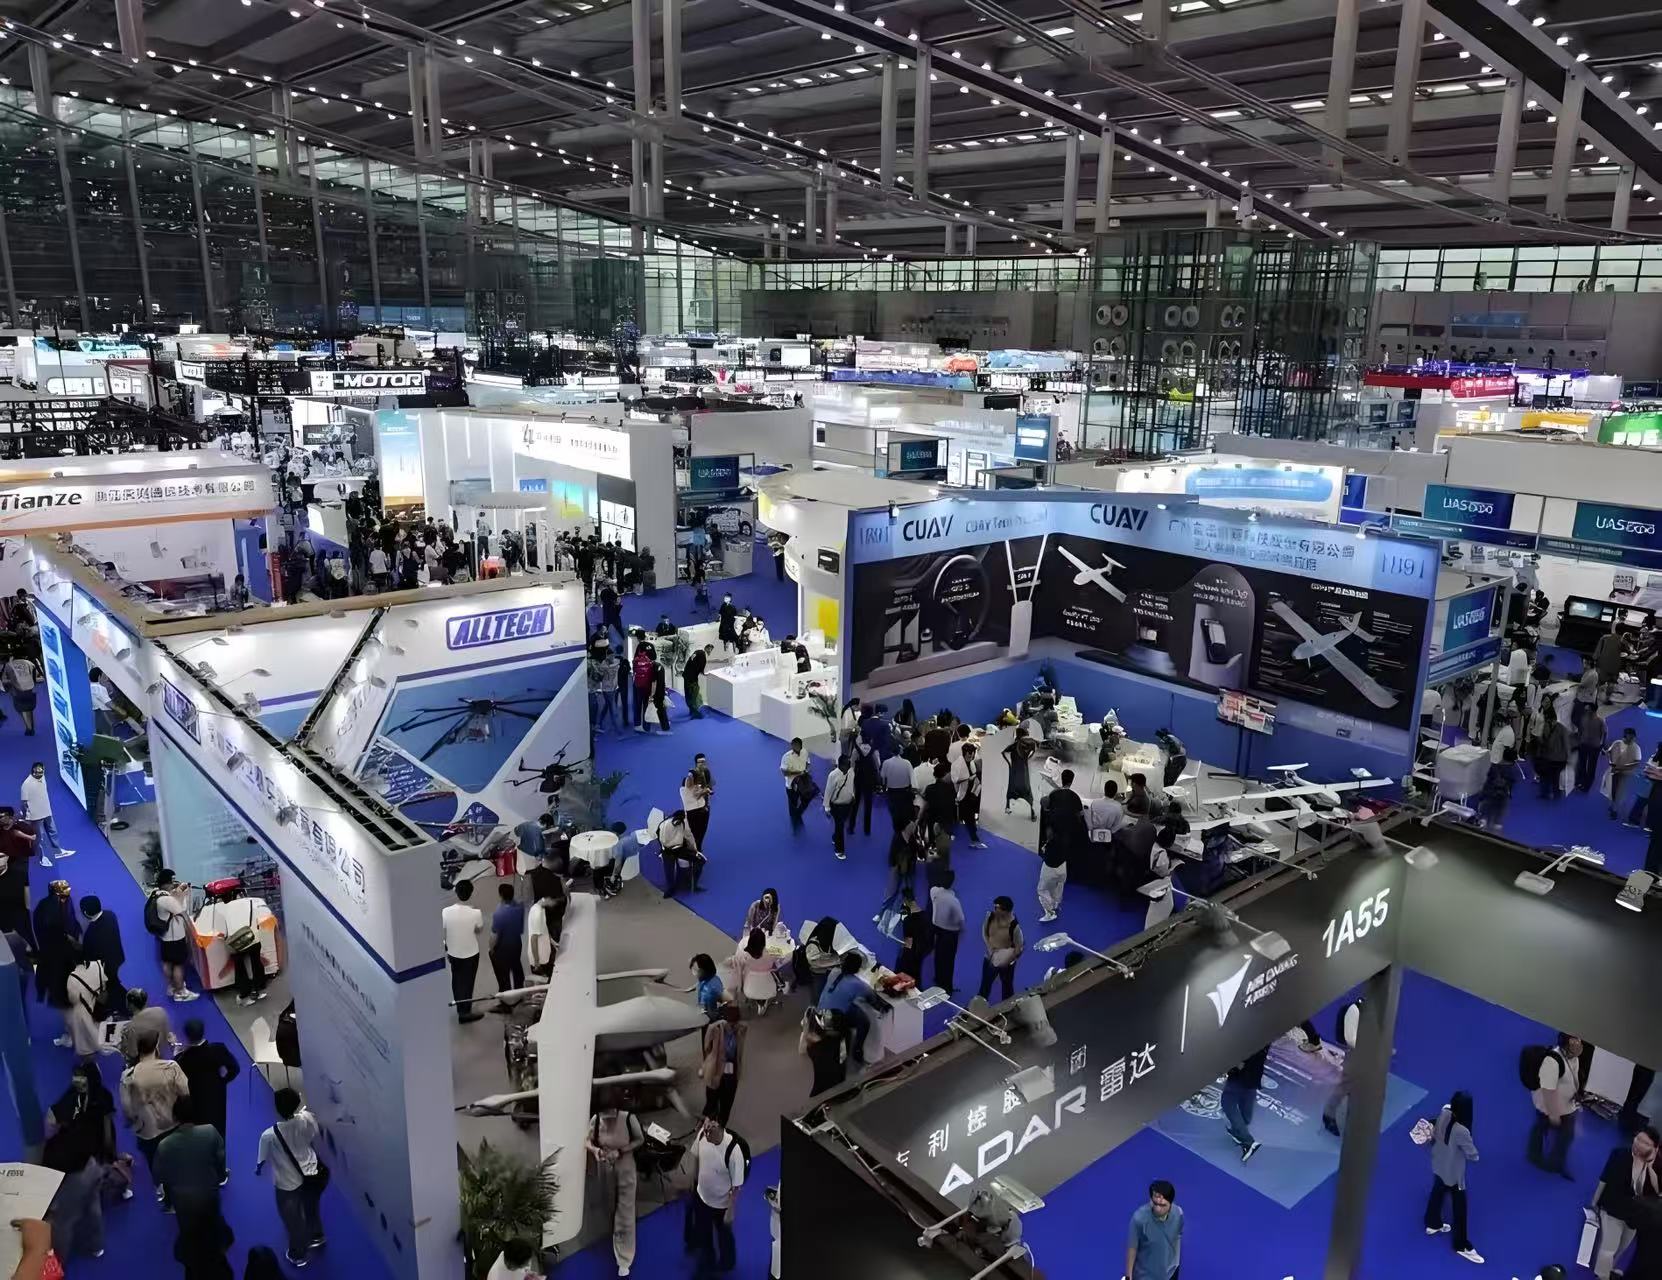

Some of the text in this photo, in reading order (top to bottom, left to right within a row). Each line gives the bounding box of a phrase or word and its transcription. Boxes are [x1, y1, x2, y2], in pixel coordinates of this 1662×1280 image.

[903, 514, 954, 541] CUAV
[1090, 504, 1148, 532] CUAV
[453, 608, 549, 645] ALLTECH
[1322, 887, 1391, 959] 1A55
[1100, 1041, 1157, 1102] 雷达
